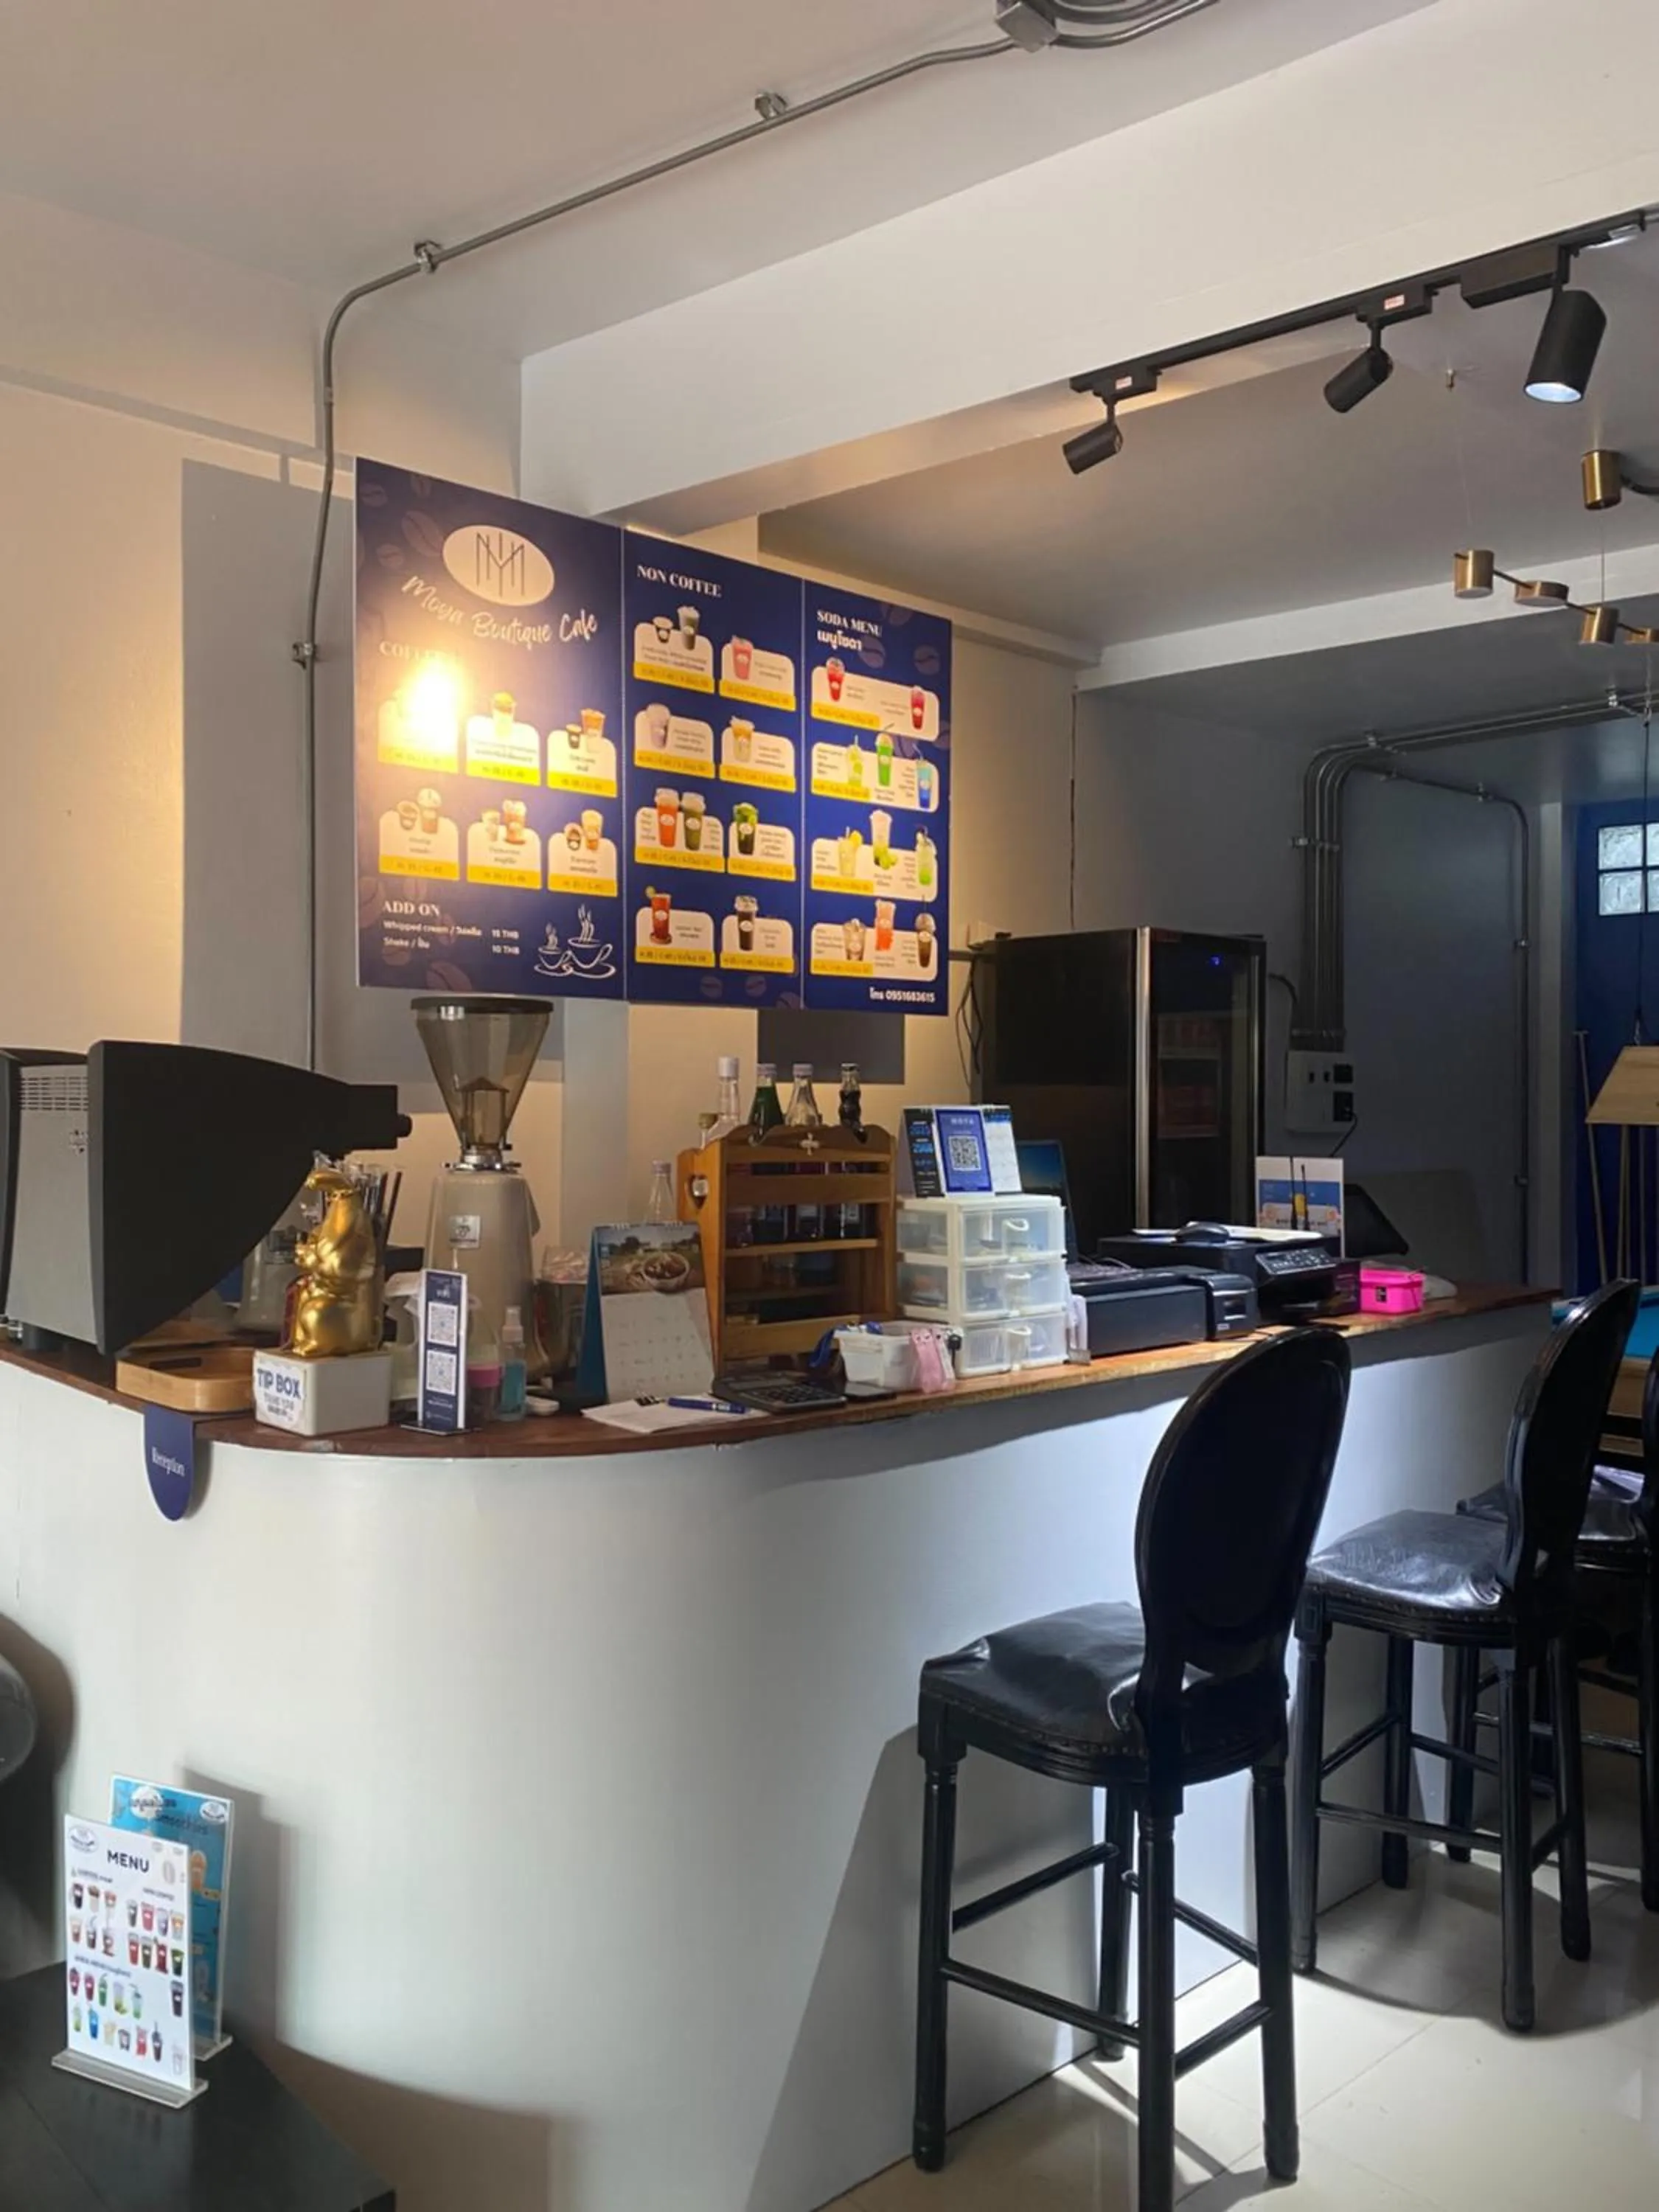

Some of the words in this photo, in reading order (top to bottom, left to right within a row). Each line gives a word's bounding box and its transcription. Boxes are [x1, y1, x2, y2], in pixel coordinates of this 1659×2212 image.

[637, 565, 667, 583] NON
[669, 572, 722, 597] COFFEE
[401, 575, 464, 624] Moya
[472, 611, 552, 650] Boutique
[816, 609, 848, 629] SODA
[850, 617, 882, 637] MENU
[383, 901, 414, 915] ADD
[418, 903, 440, 918] ON
[257, 1368, 274, 1389] TIP
[276, 1373, 301, 1400] BOX
[152, 1446, 185, 1477] Reception
[107, 1850, 150, 1874] MENU
